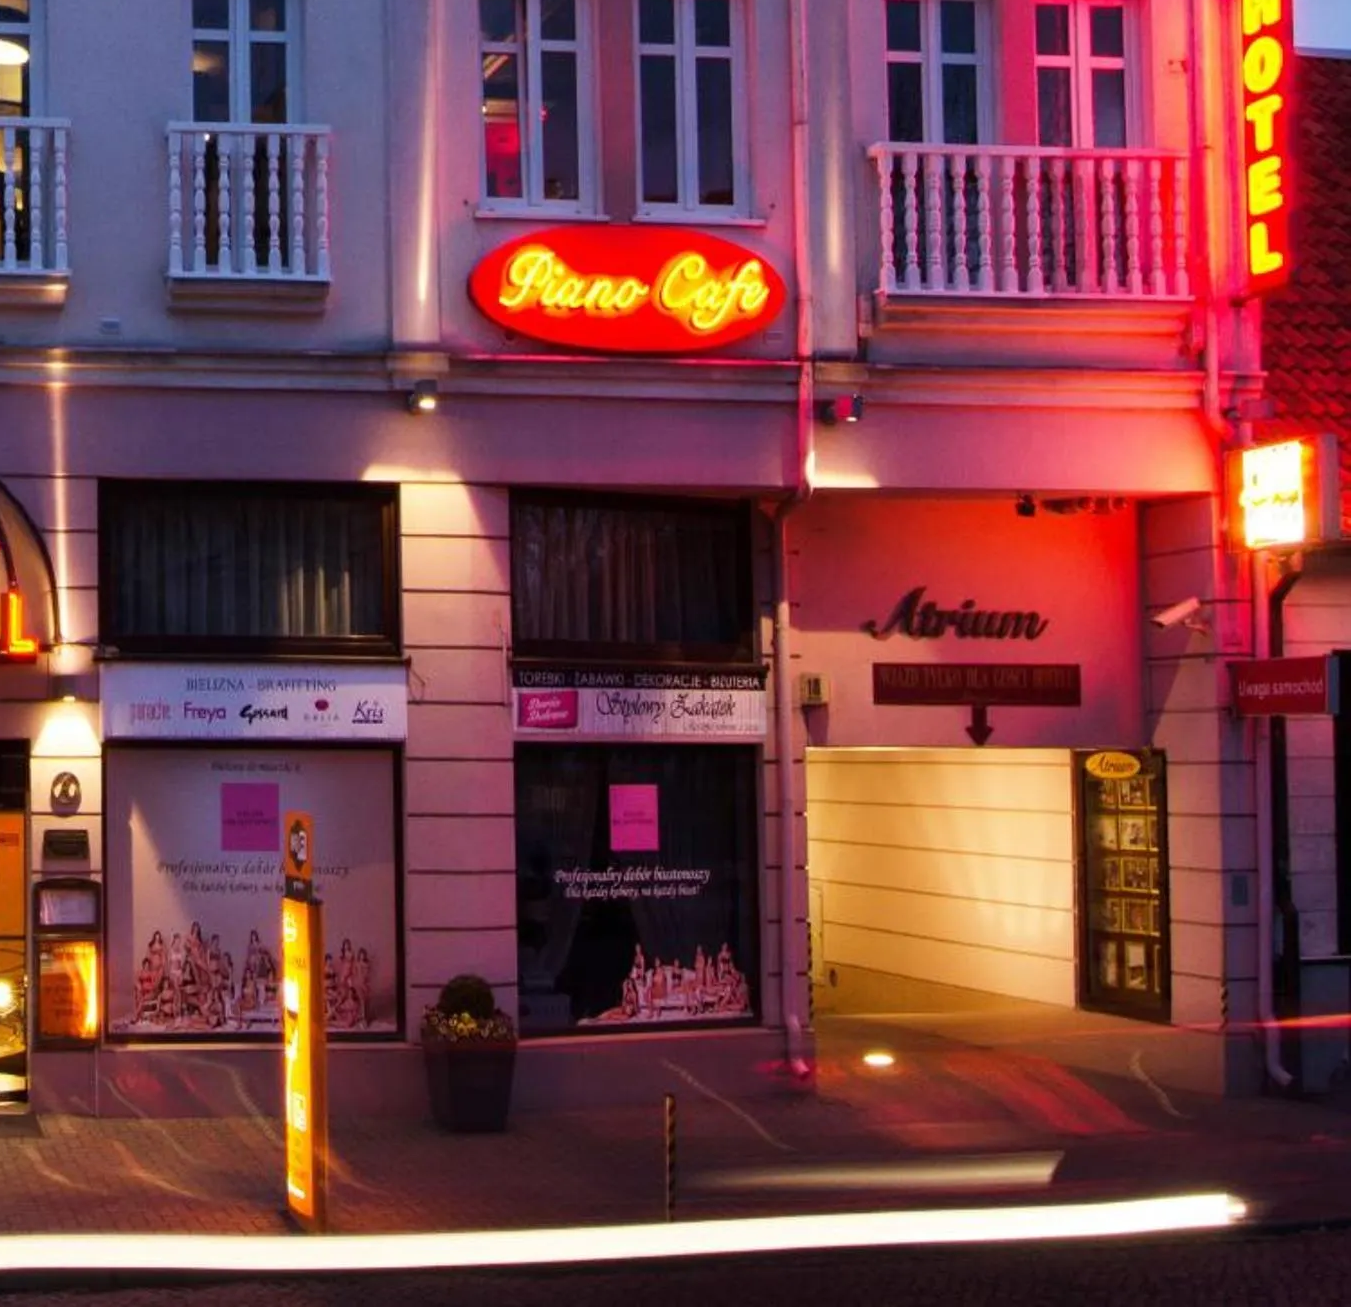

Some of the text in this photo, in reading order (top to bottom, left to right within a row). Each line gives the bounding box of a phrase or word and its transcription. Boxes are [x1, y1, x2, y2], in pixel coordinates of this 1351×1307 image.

[498, 250, 648, 310] Piano
[861, 586, 1049, 641] Atrium
[183, 701, 227, 724] Freya
[239, 703, 289, 725] Gossard
[353, 700, 384, 720] Kris
